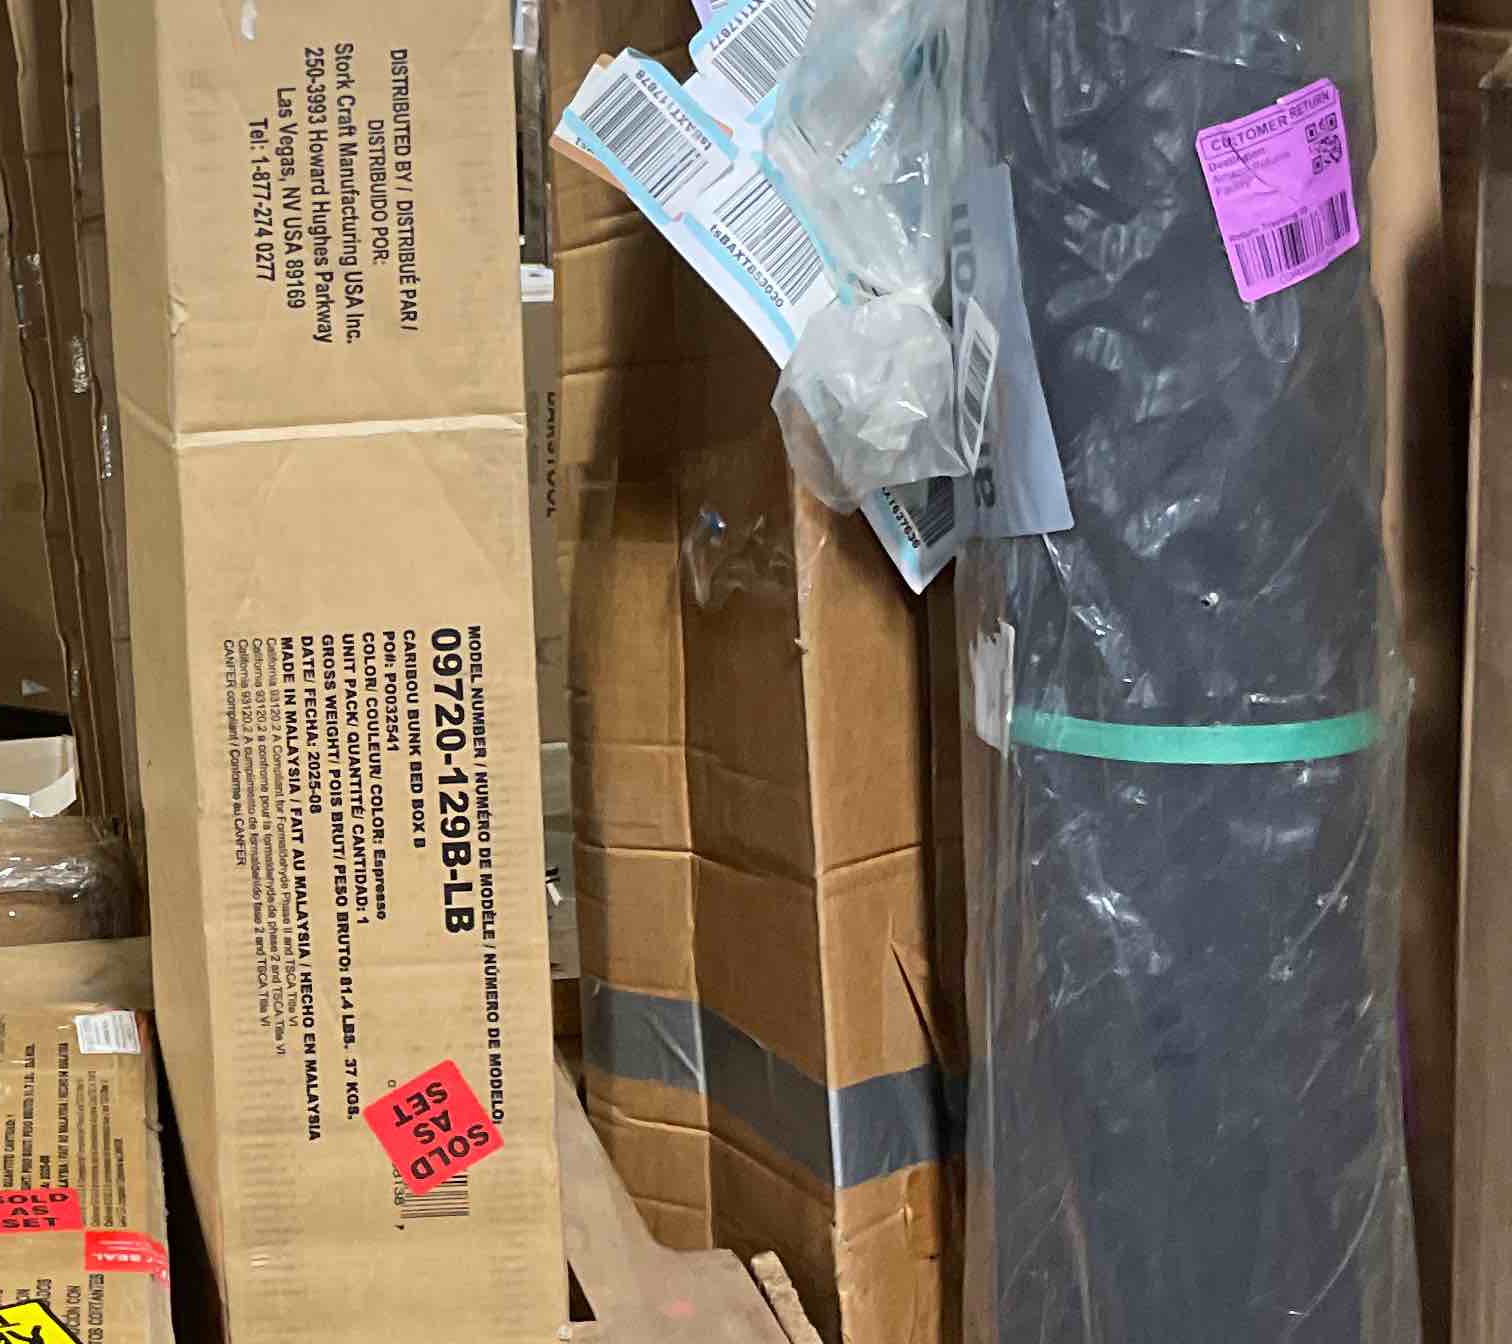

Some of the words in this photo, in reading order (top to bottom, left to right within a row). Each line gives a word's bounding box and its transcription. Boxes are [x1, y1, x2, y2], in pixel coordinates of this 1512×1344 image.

[304, 47, 327, 124] 250-3993
[334, 43, 355, 90] Stork
[276, 87, 296, 118] Las
[336, 94, 357, 137] Craft
[389, 48, 411, 156] DISTRIBUTED
[1289, 88, 1332, 121] RETURN
[248, 117, 269, 150] Tel:
[276, 122, 298, 181] Vegas,
[307, 129, 330, 195] Howard
[367, 119, 388, 222] DISTRIBUIDO
[394, 160, 413, 182] BY
[250, 155, 274, 238] 1-877-274
[281, 186, 302, 211] NV
[338, 142, 362, 266] Manufacturing
[282, 216, 303, 255] USA
[308, 200, 332, 266] Hughes
[370, 226, 389, 265] POR:
[395, 199, 421, 285] DISTRIBUÉ
[255, 242, 275, 282] 0277
[285, 259, 306, 309] 89169
[312, 271, 336, 343] Parkway
[343, 270, 364, 309] USA
[399, 288, 418, 322] PAR
[345, 313, 365, 344] Inc.
[280, 636, 295, 683] MADE
[321, 634, 336, 690] GROSS
[341, 633, 356, 673] UNIT
[361, 631, 377, 692] COLOR/
[402, 629, 419, 703] CARIBOU
[467, 625, 483, 683] MODEL
[283, 688, 296, 705] IN
[303, 687, 319, 747] FECHA:
[343, 678, 359, 727] PACK/
[365, 697, 382, 779] COULEUR/
[407, 708, 421, 756] BUNK
[470, 687, 487, 758] NUMBER
[284, 710, 301, 794] MALAYSIA
[307, 751, 322, 814] 2025-08
[328, 768, 344, 807] POIS
[409, 761, 423, 794] BED
[431, 627, 475, 933] 09720-129B-LB
[289, 807, 304, 844] FAIT
[370, 783, 384, 844] COLOR:
[411, 798, 425, 833] BOX
[291, 848, 306, 871] AU
[351, 823, 368, 911] CANTIDAD:
[478, 847, 492, 869] DE
[333, 864, 348, 907] PESO
[371, 848, 386, 920] Espresso
[294, 875, 311, 959] MALAYSIA
[356, 916, 370, 924] 1
[336, 911, 351, 972] BRUTO:
[299, 971, 314, 1028] HECHO
[303, 1032, 316, 1054] EN
[341, 1014, 355, 1049] LBS.
[487, 1027, 501, 1049] DE
[344, 1058, 357, 1077] 37
[303, 1059, 321, 1141] MALAYSIA
[345, 1081, 359, 1120] KGS.
[392, 1081, 449, 1128] SET
[412, 1109, 452, 1145] AS
[410, 1124, 490, 1180] SOLD
[1, 1217, 59, 1229] SET
[10, 1205, 49, 1216] AS
